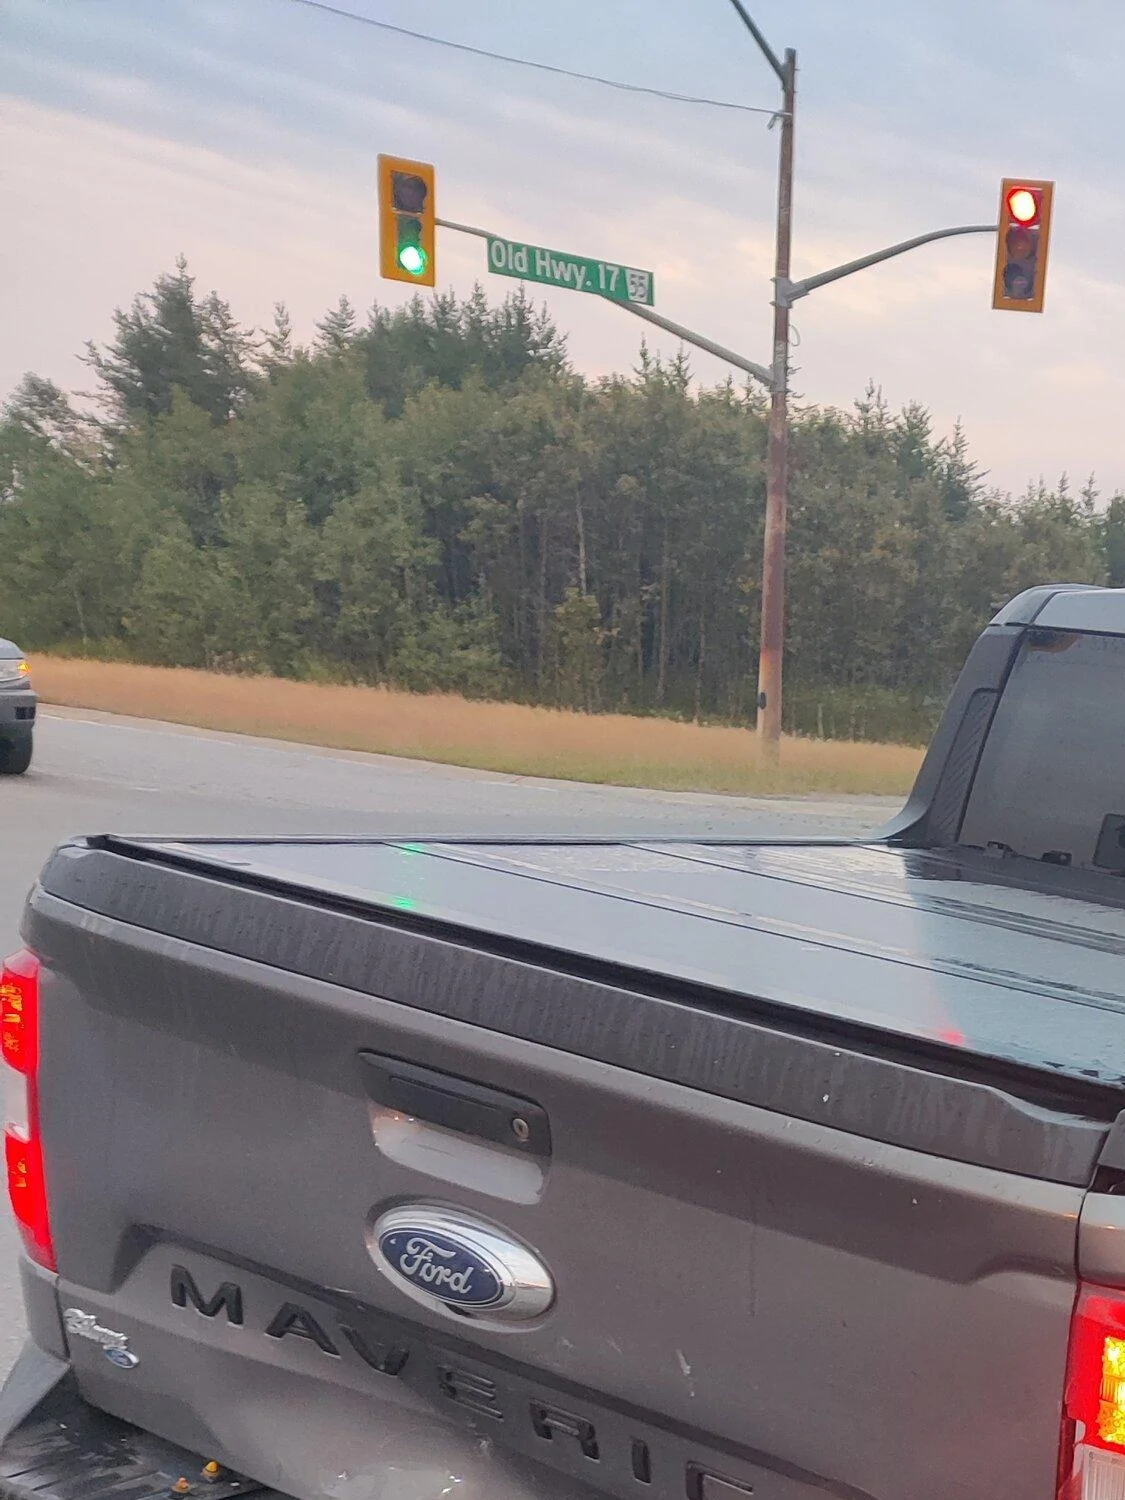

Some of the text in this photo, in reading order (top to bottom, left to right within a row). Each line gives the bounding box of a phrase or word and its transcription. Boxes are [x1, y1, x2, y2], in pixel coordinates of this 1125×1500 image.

[490, 240, 621, 292] Old Hwy. 17
[400, 1236, 474, 1295] Ford
